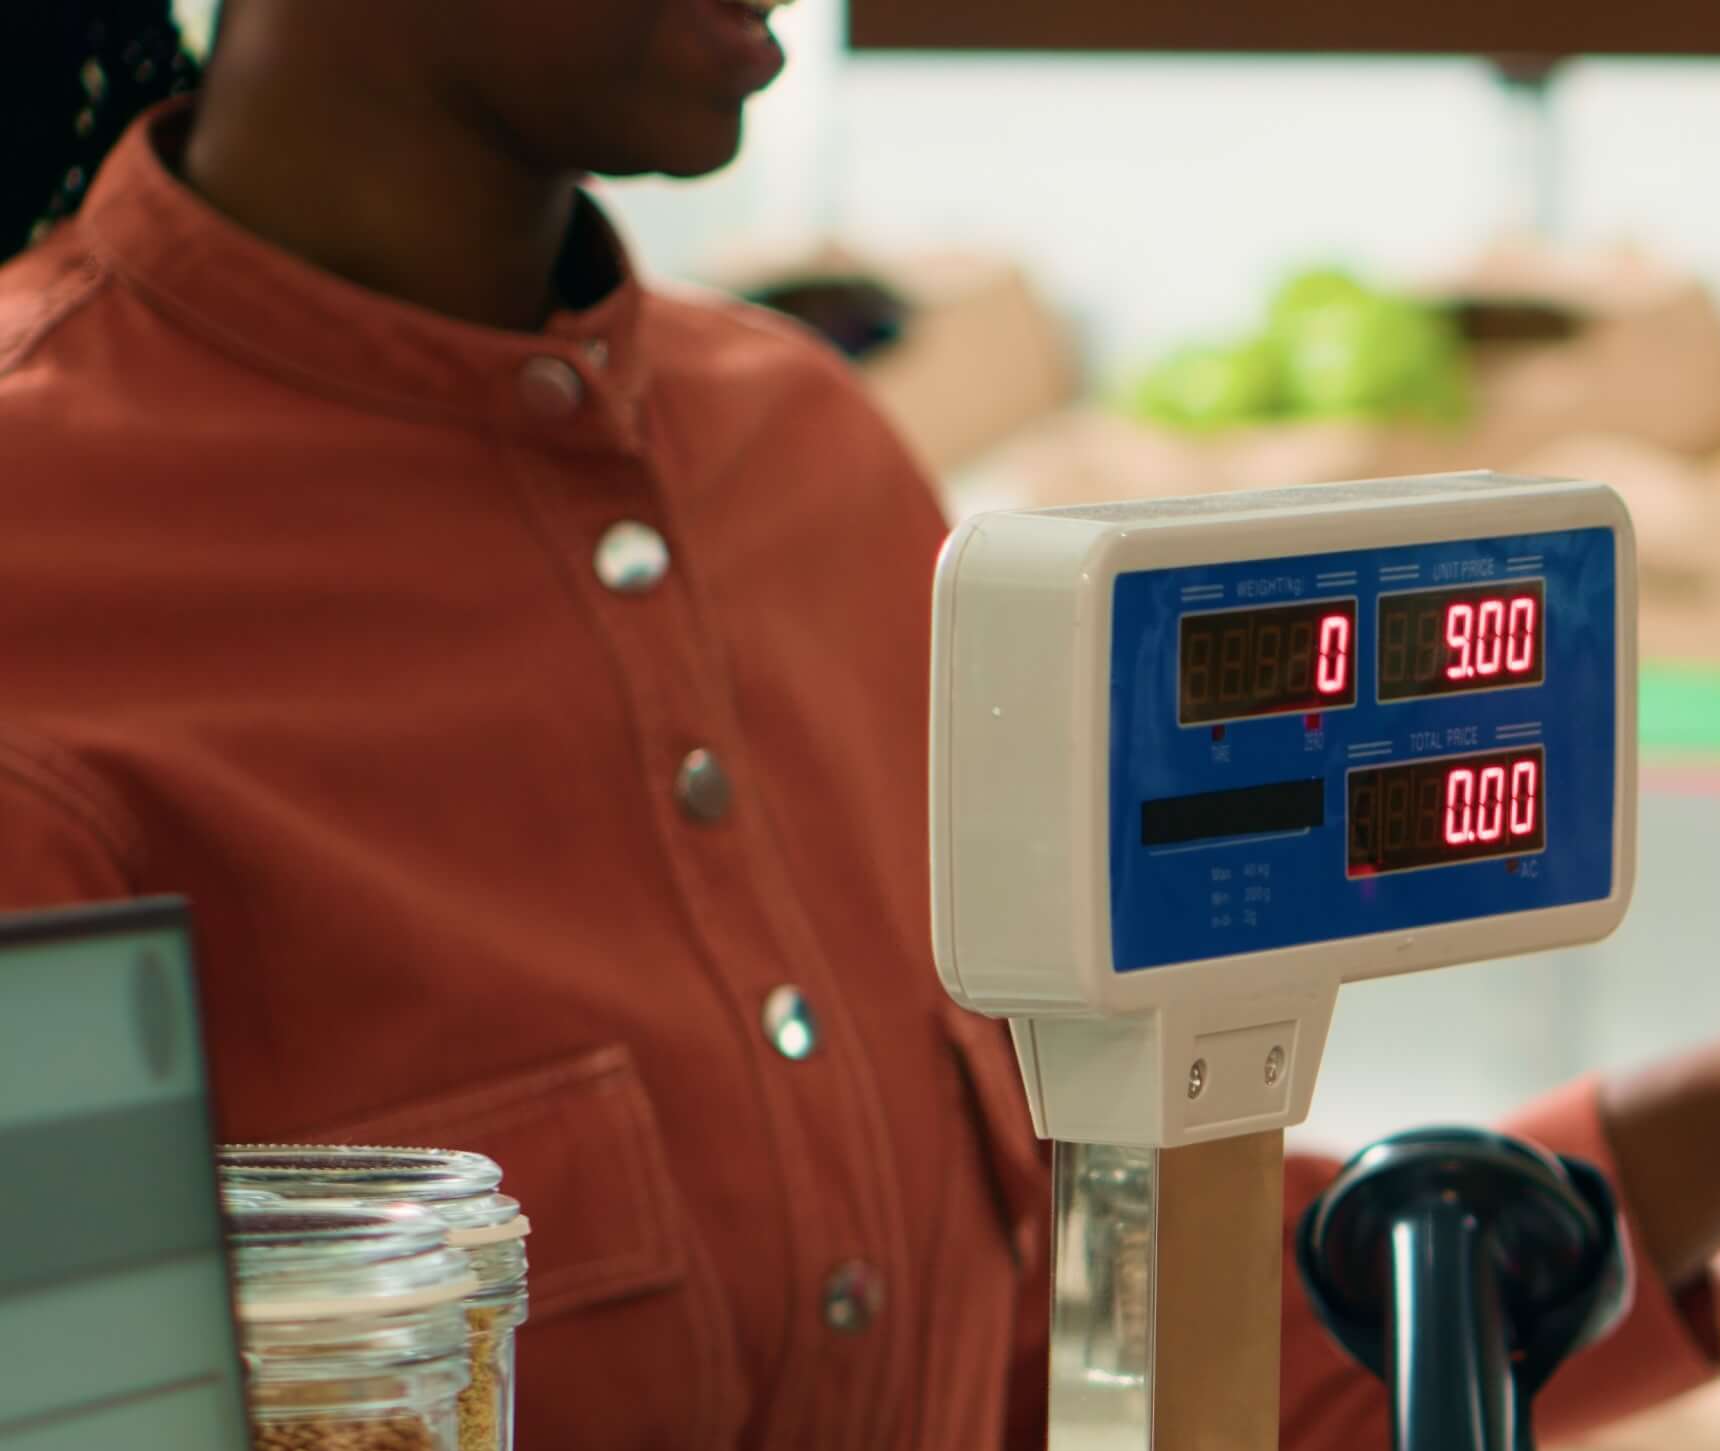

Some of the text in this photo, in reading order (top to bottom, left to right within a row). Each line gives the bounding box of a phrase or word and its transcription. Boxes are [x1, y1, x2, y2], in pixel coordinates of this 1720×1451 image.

[1461, 558, 1495, 577] PRICE
[1316, 616, 1349, 693] 0
[1447, 598, 1534, 680] 9.00
[1410, 726, 1479, 752] TOTAL PRICE
[1446, 761, 1536, 844] 0.00
[1520, 860, 1539, 878] AC
